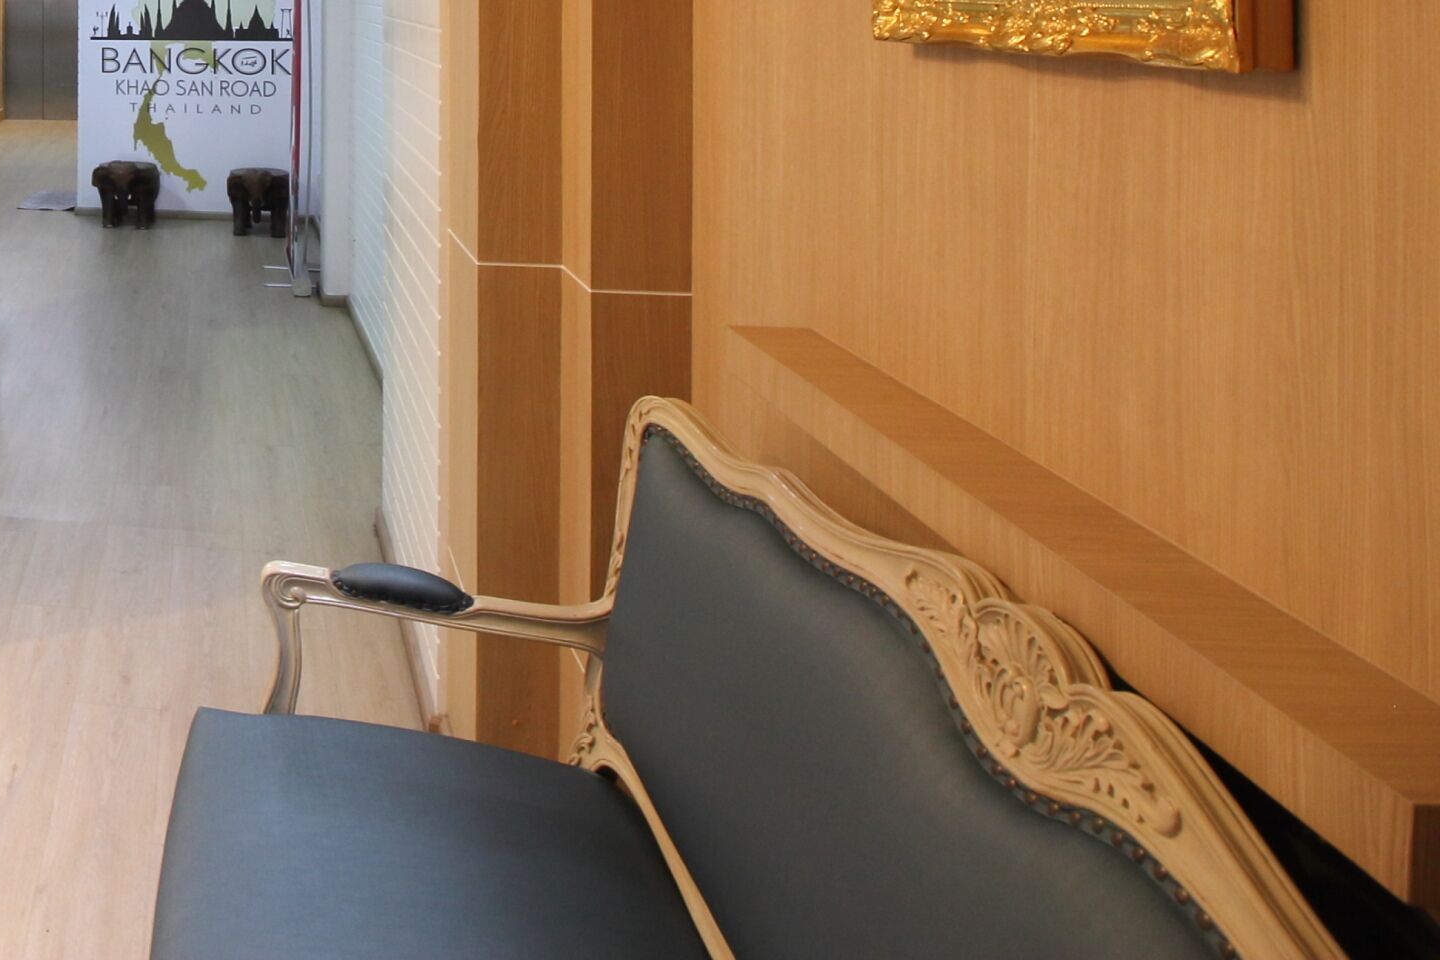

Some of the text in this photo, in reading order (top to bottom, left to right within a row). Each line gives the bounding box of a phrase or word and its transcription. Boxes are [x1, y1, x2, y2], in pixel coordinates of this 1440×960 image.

[101, 47, 291, 76] BANGKOK
[115, 79, 277, 98] KHAO SAN ROAD
[130, 102, 262, 116] THAILAND
